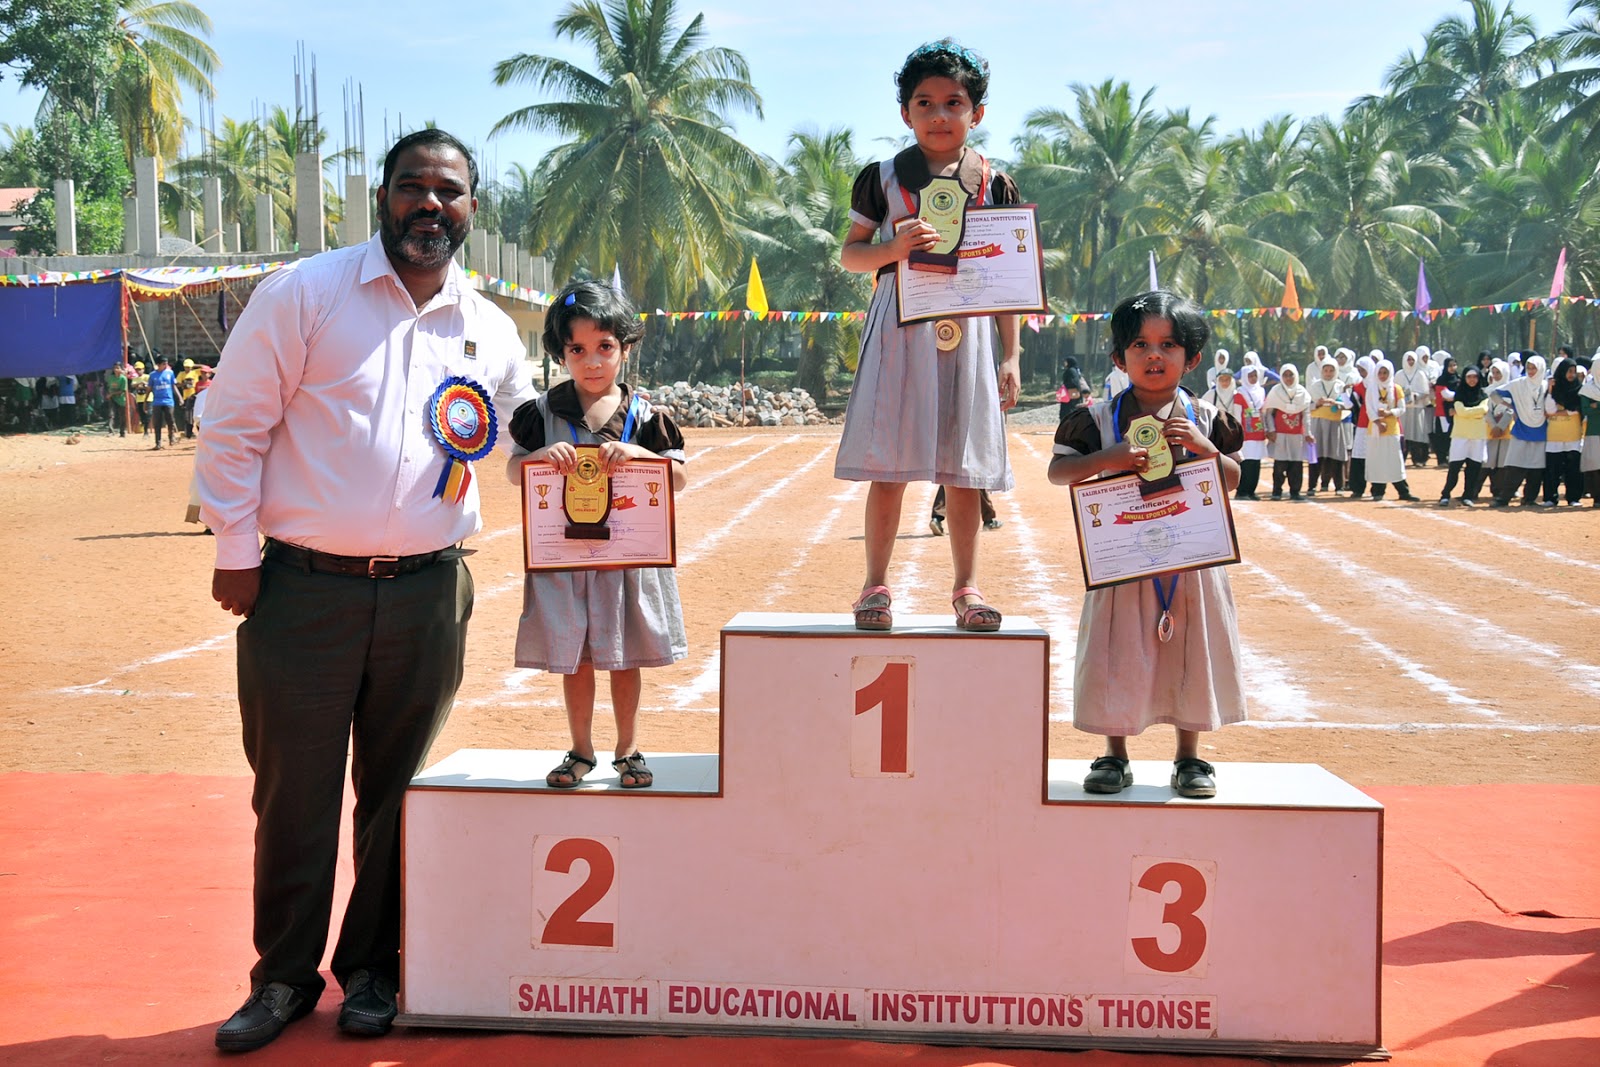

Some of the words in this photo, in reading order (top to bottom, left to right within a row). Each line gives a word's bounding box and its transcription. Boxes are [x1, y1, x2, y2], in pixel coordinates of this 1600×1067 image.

[960, 250, 982, 258] SPORTS
[982, 245, 993, 254] DAY
[1082, 488, 1108, 497] SALIHATH
[1108, 484, 1126, 492] GROUP
[614, 498, 626, 506] DAY
[1129, 499, 1170, 512] Certificate
[1146, 509, 1167, 518] SPORTS
[1168, 504, 1178, 513] DAY
[854, 663, 909, 773] 1
[541, 837, 615, 947] 2
[1131, 861, 1208, 972] 3
[518, 983, 648, 1015] SALIHATH
[668, 985, 857, 1022] EDUCATIONAL
[872, 992, 1084, 1028] INSTITUTTIONS
[1098, 999, 1211, 1030] THONSE
